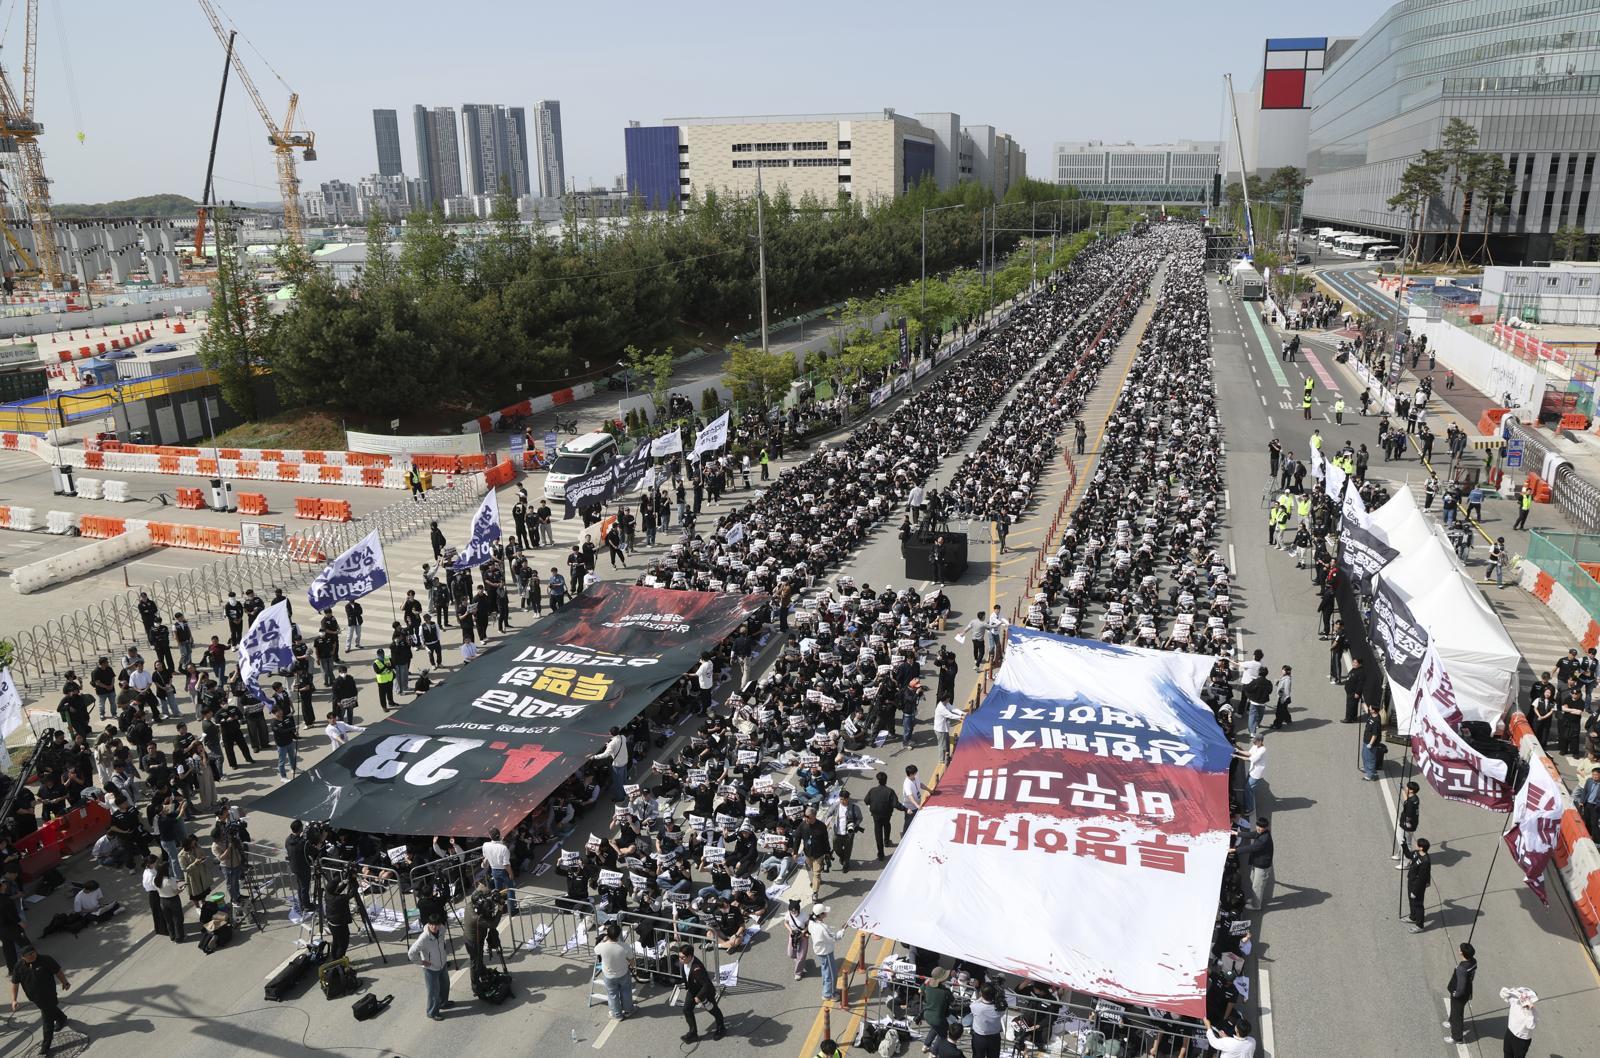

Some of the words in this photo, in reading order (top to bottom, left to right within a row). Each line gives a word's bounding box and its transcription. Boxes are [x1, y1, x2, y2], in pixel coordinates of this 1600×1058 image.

[498, 665, 615, 701] 투명화
[472, 689, 590, 719] 성과급
[355, 733, 564, 787] 4.23
[991, 725, 1196, 766] 상한폐지
[950, 811, 1190, 874] 투명하게
